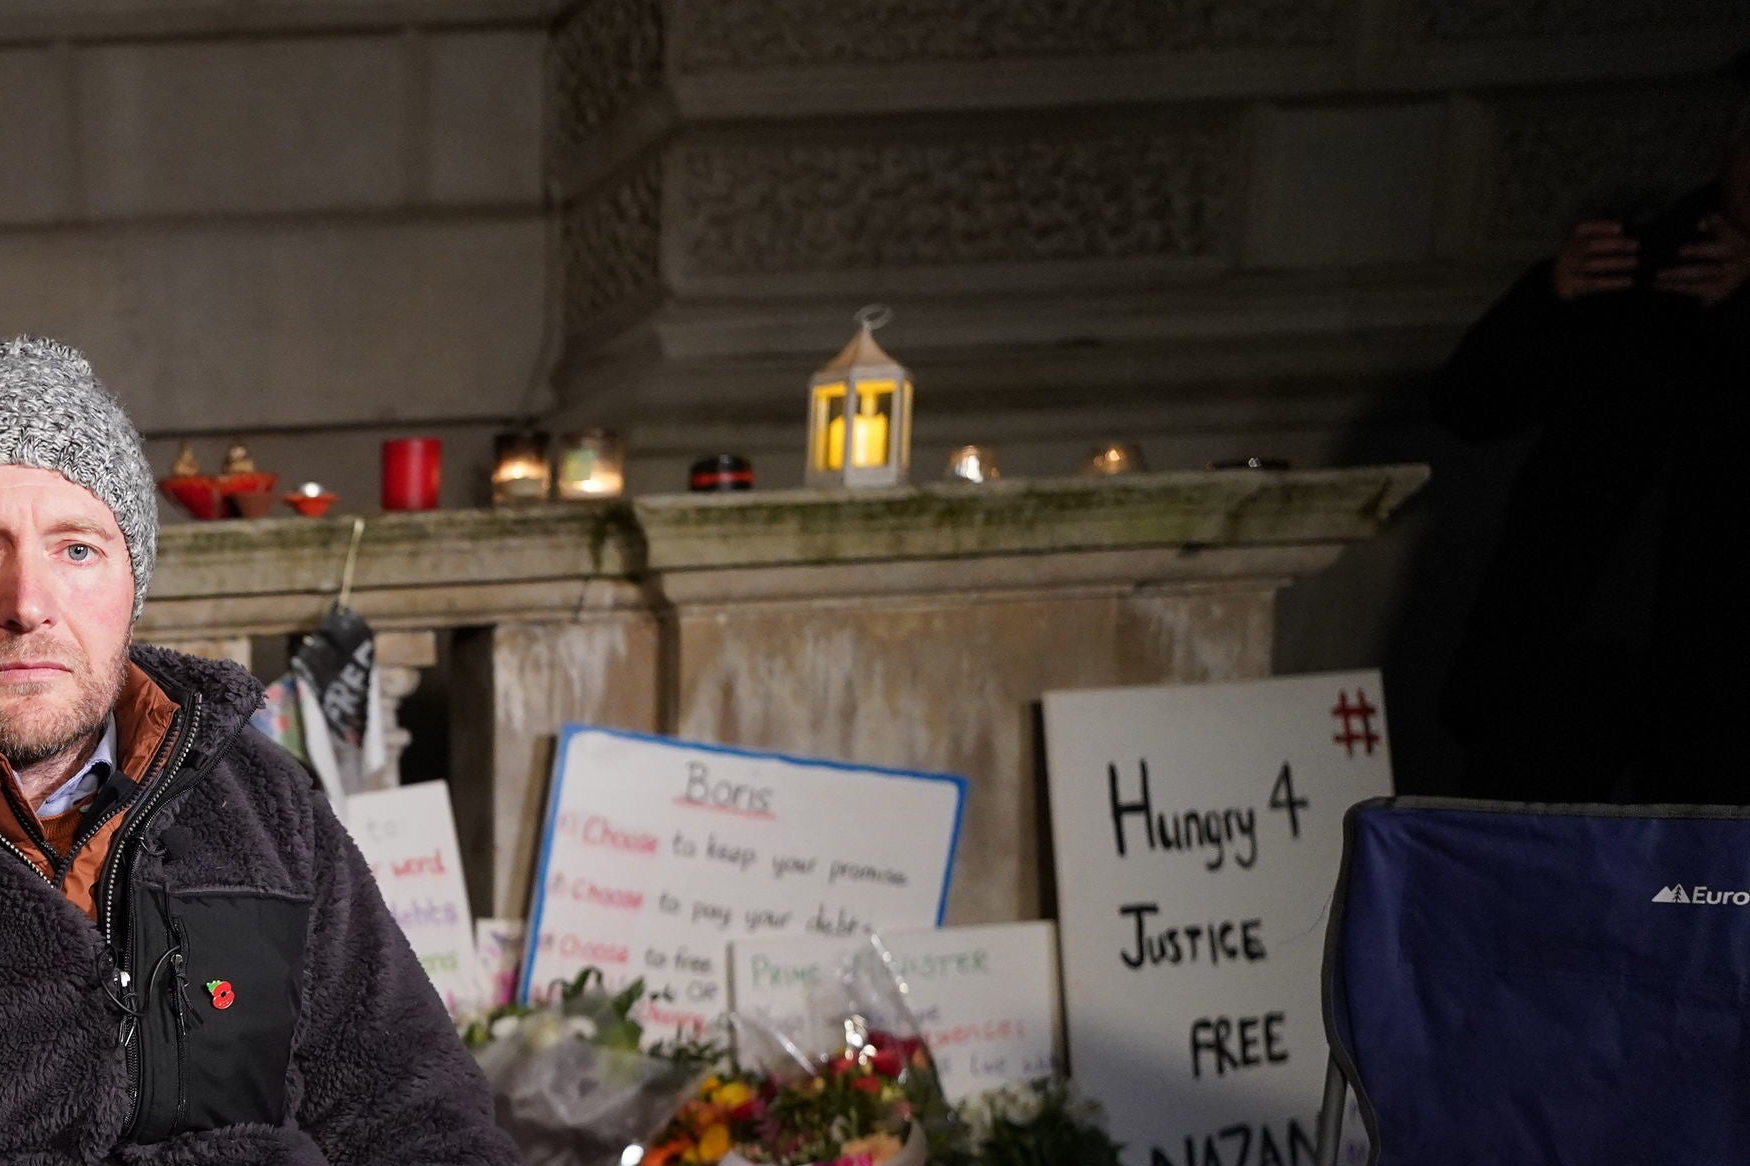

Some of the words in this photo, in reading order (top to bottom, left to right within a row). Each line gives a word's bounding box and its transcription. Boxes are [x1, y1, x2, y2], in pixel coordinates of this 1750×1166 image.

[1331, 690, 1379, 755] #
[684, 761, 774, 812] Boris
[1107, 759, 1256, 871] Hungry
[1268, 761, 1309, 838] 4
[581, 816, 658, 854] Choose
[672, 832, 696, 857] to
[772, 854, 817, 880] your
[572, 879, 644, 911] Choose
[659, 891, 680, 915] to
[744, 907, 794, 931] your
[1190, 1011, 1289, 1080] FREE
